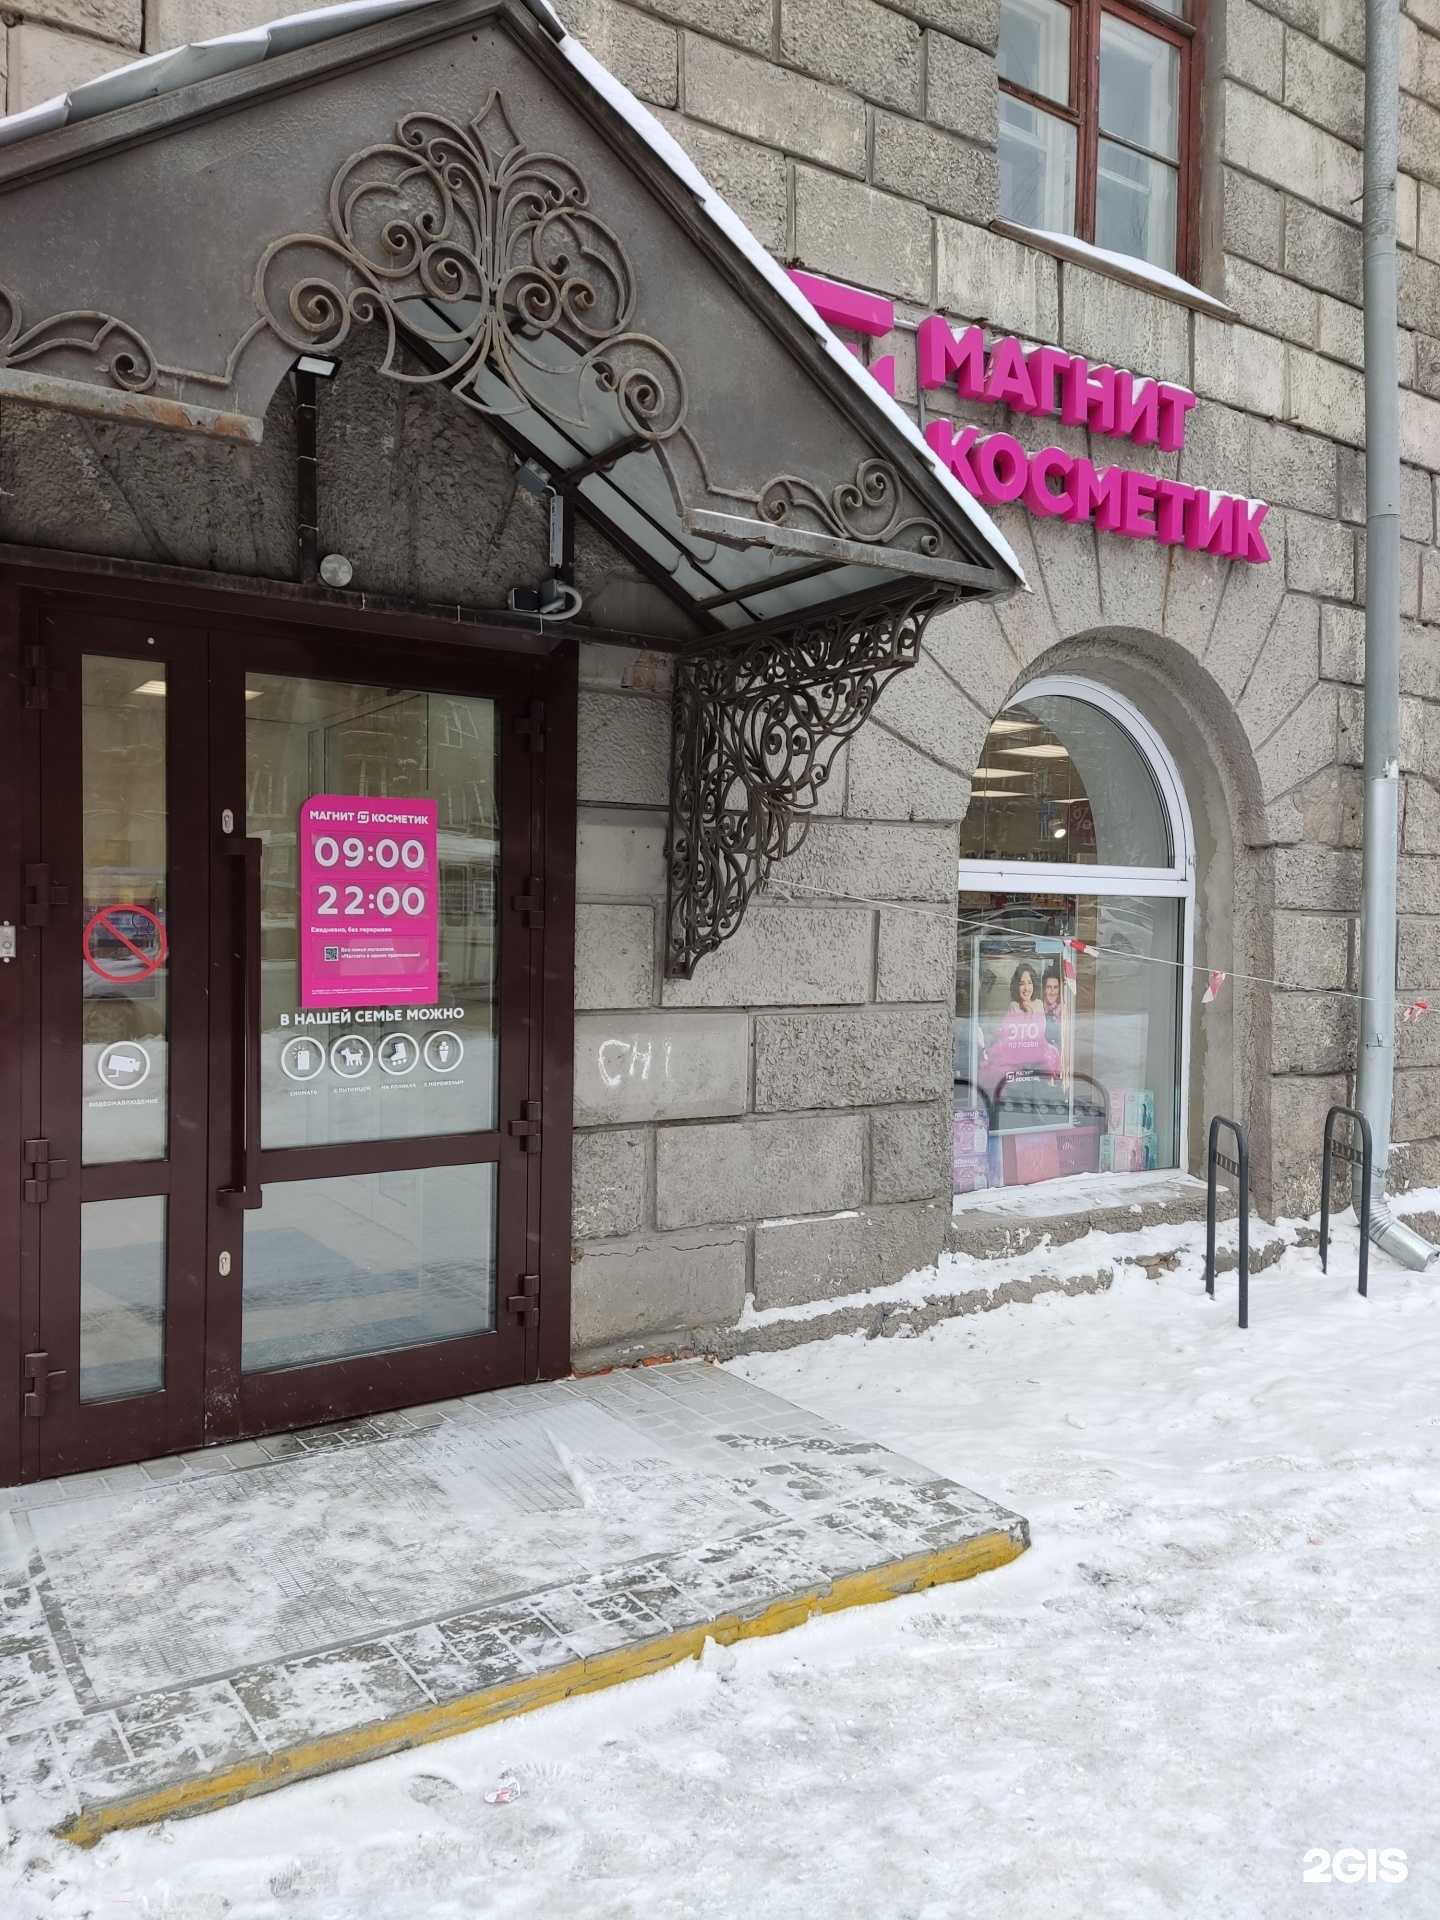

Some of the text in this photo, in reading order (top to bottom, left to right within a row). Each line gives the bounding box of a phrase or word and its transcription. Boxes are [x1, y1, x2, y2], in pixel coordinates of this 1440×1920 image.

[918, 315, 1196, 452] МАГНИТ
[924, 417, 1272, 564] КОСМЕТИК
[309, 810, 429, 825] МАГНИТ КОСМЕТИК
[314, 836, 425, 869] 09:00
[317, 885, 425, 916] 22:00
[280, 1007, 465, 1026] В НАШЕЙ СЕМЬЕ МОЖНО
[1008, 1023, 1039, 1040] ЭТО
